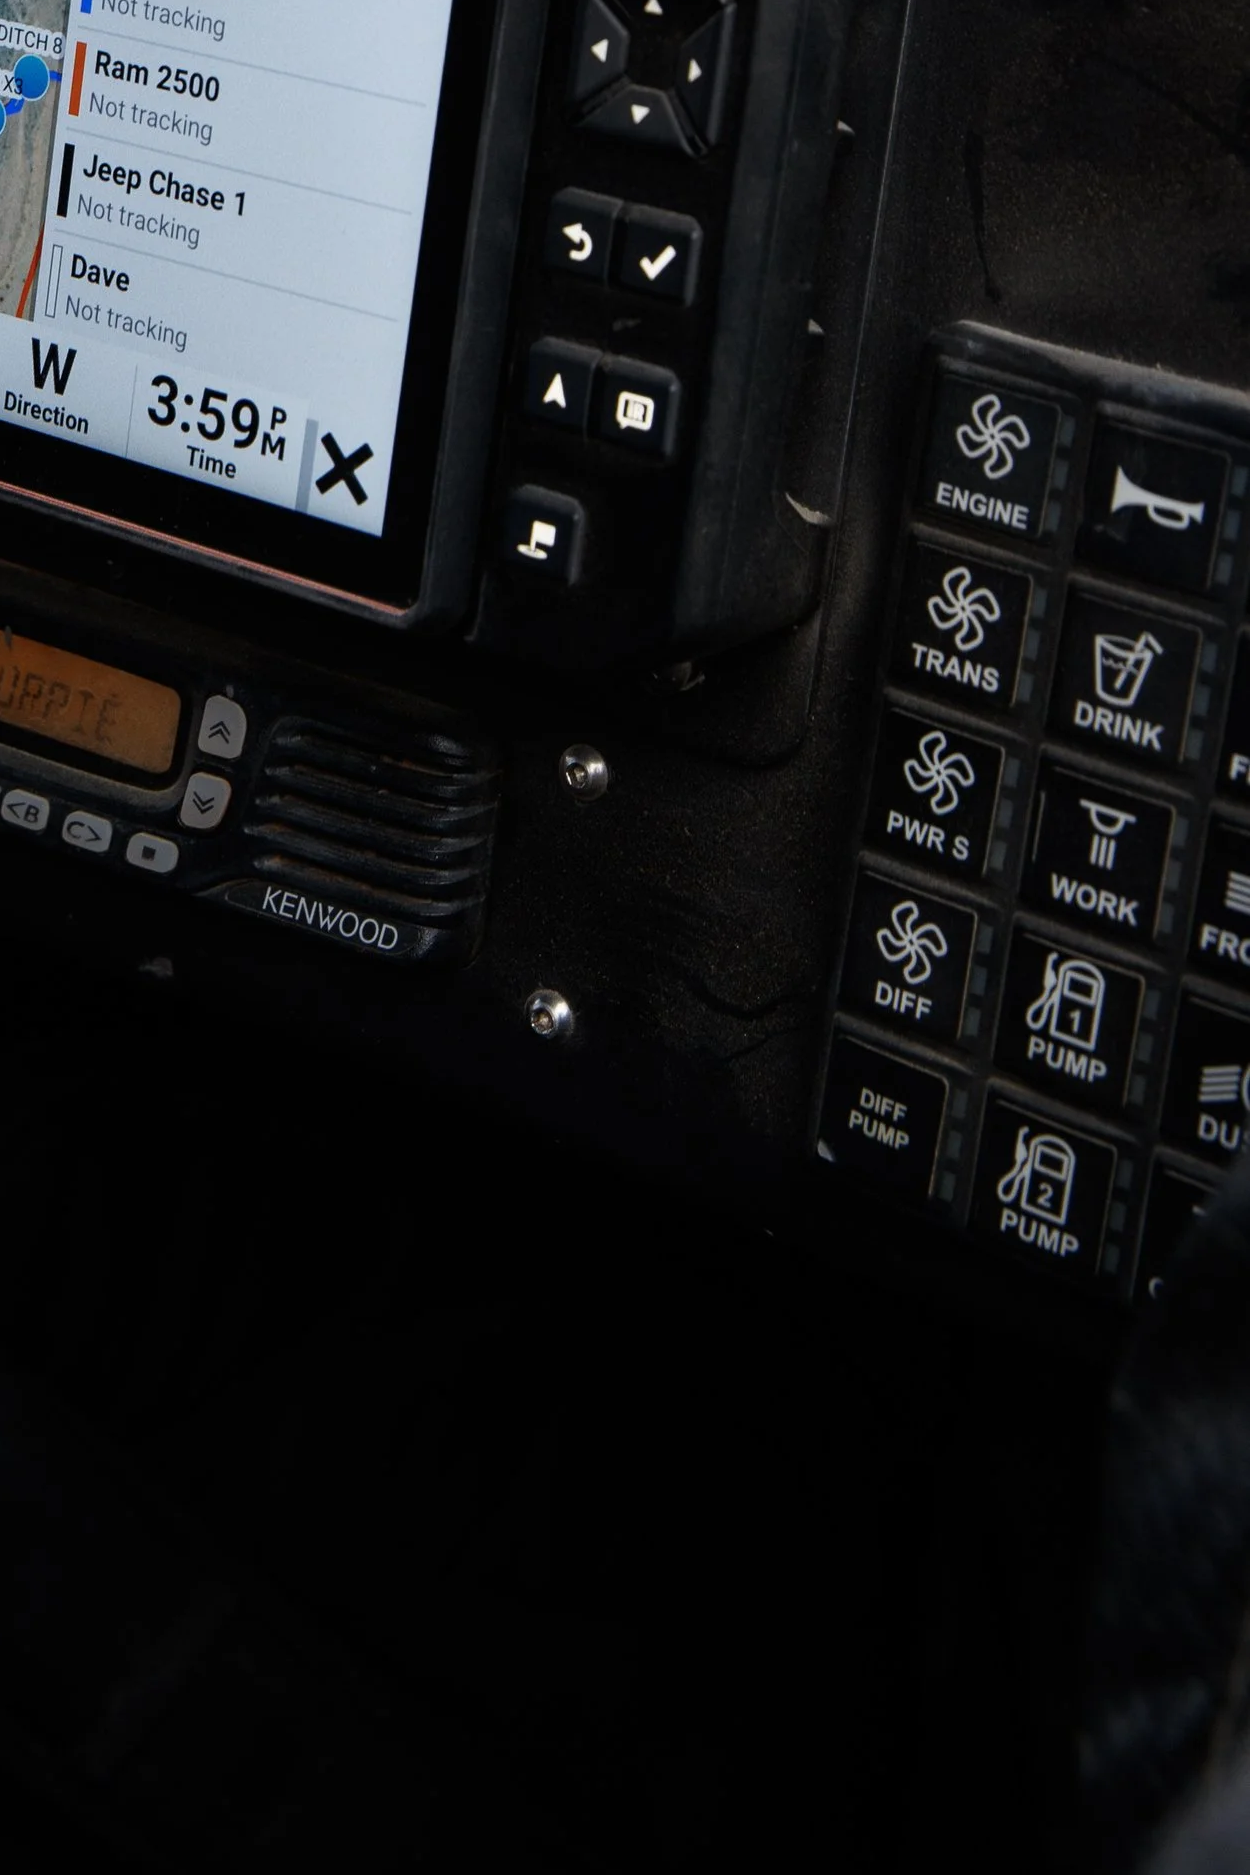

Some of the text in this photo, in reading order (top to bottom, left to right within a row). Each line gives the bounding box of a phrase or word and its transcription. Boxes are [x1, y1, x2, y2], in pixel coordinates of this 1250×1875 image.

[52, 36, 63, 54] 8
[143, 0, 226, 42] tracking
[3, 75, 23, 96] X3
[93, 49, 221, 103] Ram 2500
[89, 92, 214, 146] Not tracking
[83, 154, 248, 216] Jeep Chase 1
[76, 193, 201, 250] Not tracking
[70, 254, 131, 293] Dave
[65, 294, 189, 353] Not tracking
[31, 337, 78, 397] W
[3, 390, 90, 435] Direction
[147, 374, 261, 450] 3:59
[186, 444, 237, 479] Time
[935, 481, 1030, 530] ENGINE
[911, 642, 1000, 692] TRANS
[1073, 700, 1165, 752] DRINK
[886, 811, 971, 862] PWR S
[261, 884, 400, 951] KENWOOD
[1051, 873, 1140, 926] WORK
[874, 982, 932, 1020] DIFF
[1068, 1010, 1082, 1034] 1
[1027, 1037, 1108, 1083] PUMP
[859, 1087, 907, 1122] DIFF
[848, 1109, 910, 1150] PUMP
[1036, 1182, 1054, 1208] 2
[999, 1207, 1080, 1258] PUMP
